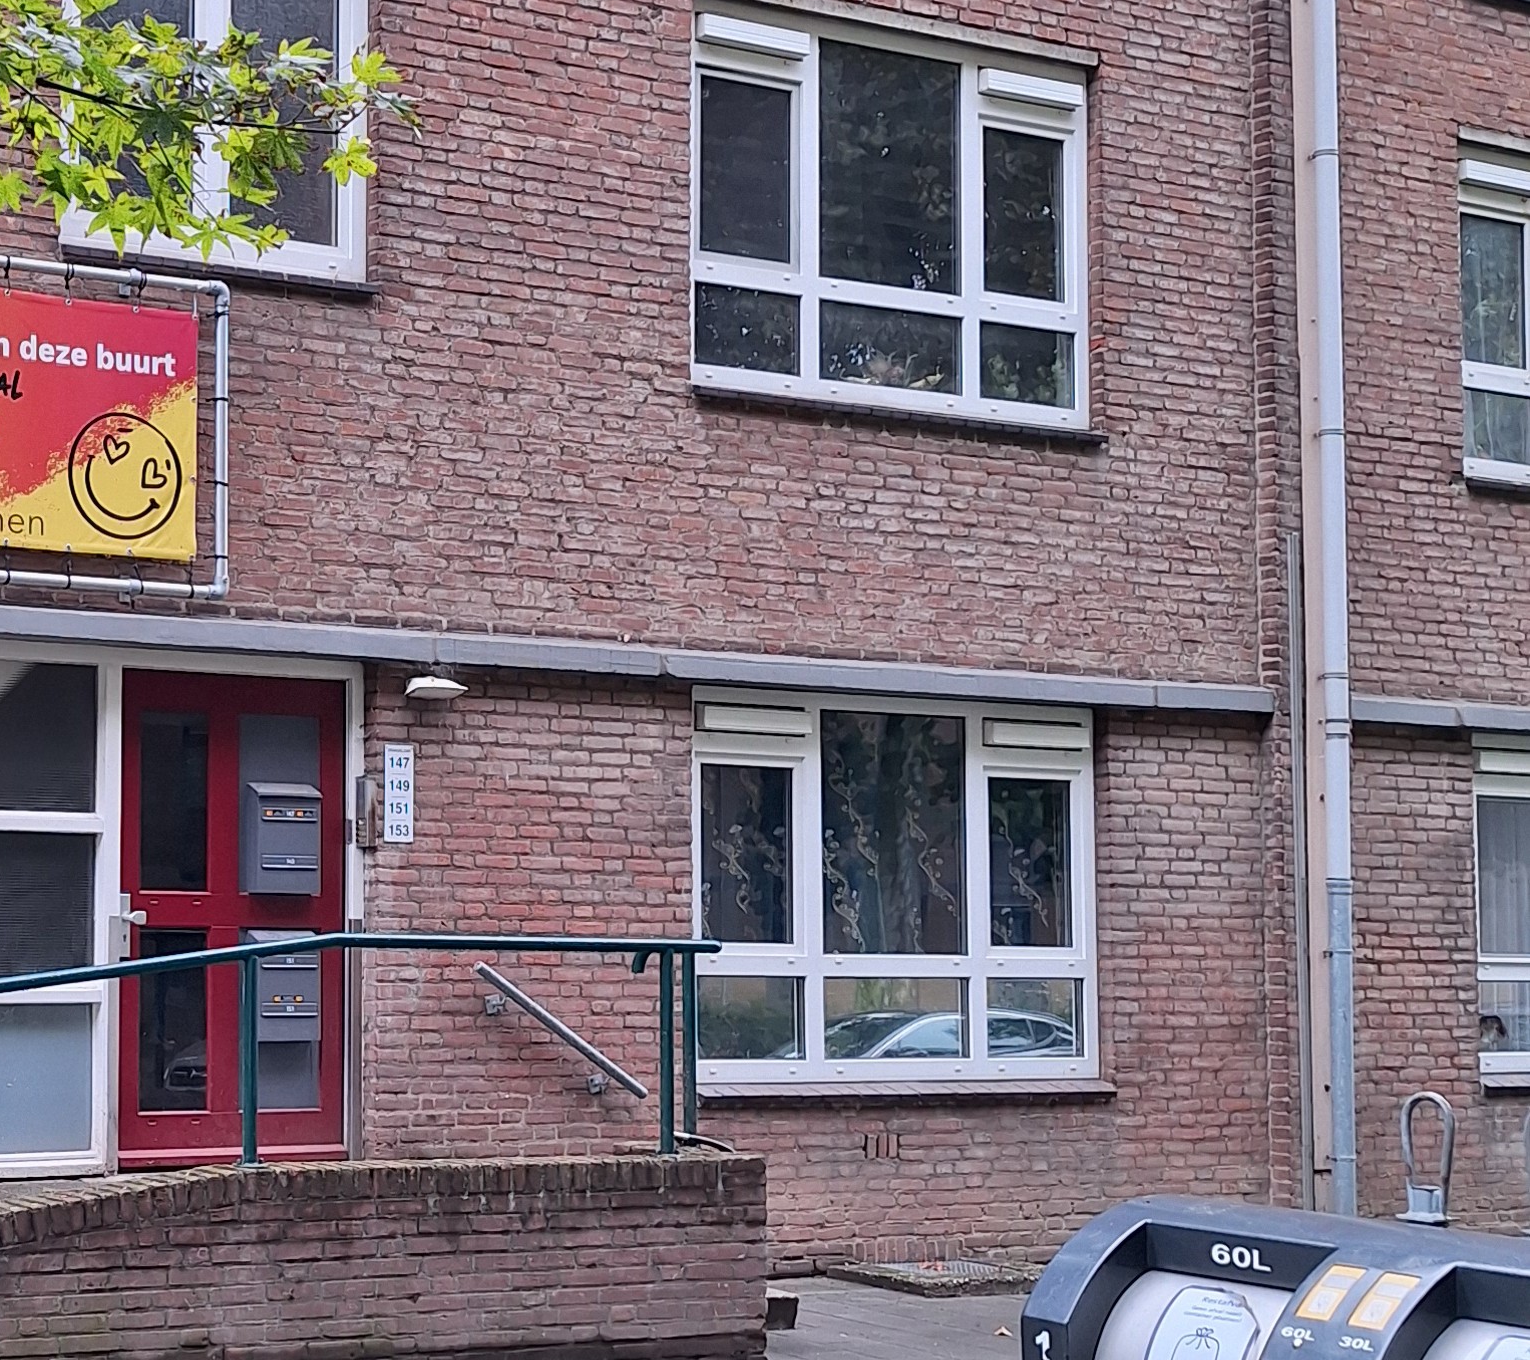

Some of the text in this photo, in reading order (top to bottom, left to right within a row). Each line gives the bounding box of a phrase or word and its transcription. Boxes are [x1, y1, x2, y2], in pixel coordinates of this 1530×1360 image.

[19, 334, 87, 366] deze
[97, 343, 176, 377] buurt
[389, 757, 410, 769] 147
[389, 780, 410, 792] 149
[389, 803, 410, 815] 151
[389, 825, 410, 837] 153
[1211, 1243, 1272, 1272] 60L
[1281, 1326, 1374, 1352] 60L 30L
